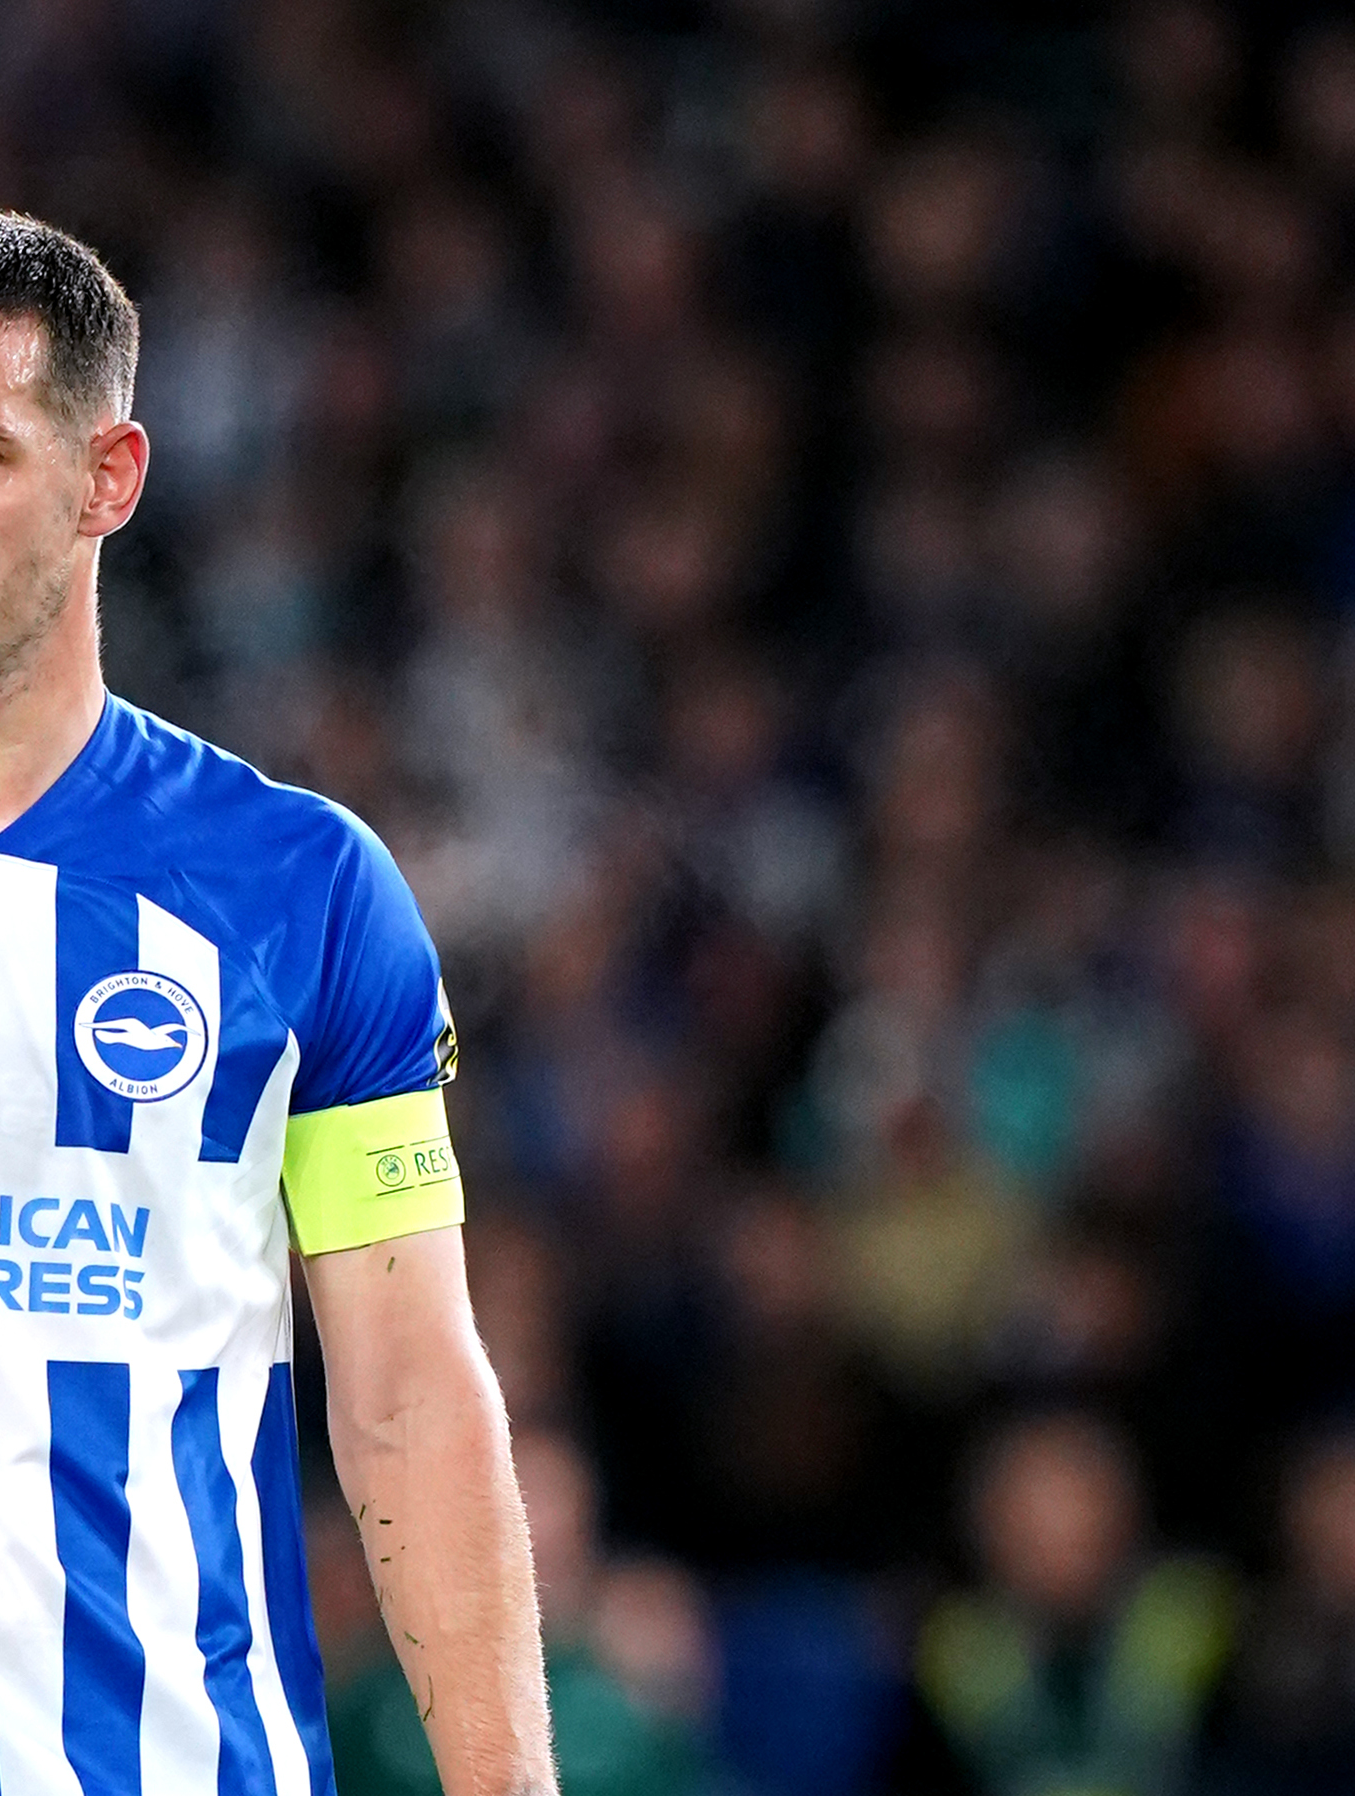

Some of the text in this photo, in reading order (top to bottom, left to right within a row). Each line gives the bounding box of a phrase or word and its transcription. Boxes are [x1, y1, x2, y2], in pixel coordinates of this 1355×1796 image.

[89, 976, 194, 1015] BRIGHTON & HOVE
[109, 1078, 158, 1095] ALBION
[414, 1146, 452, 1177] RES
